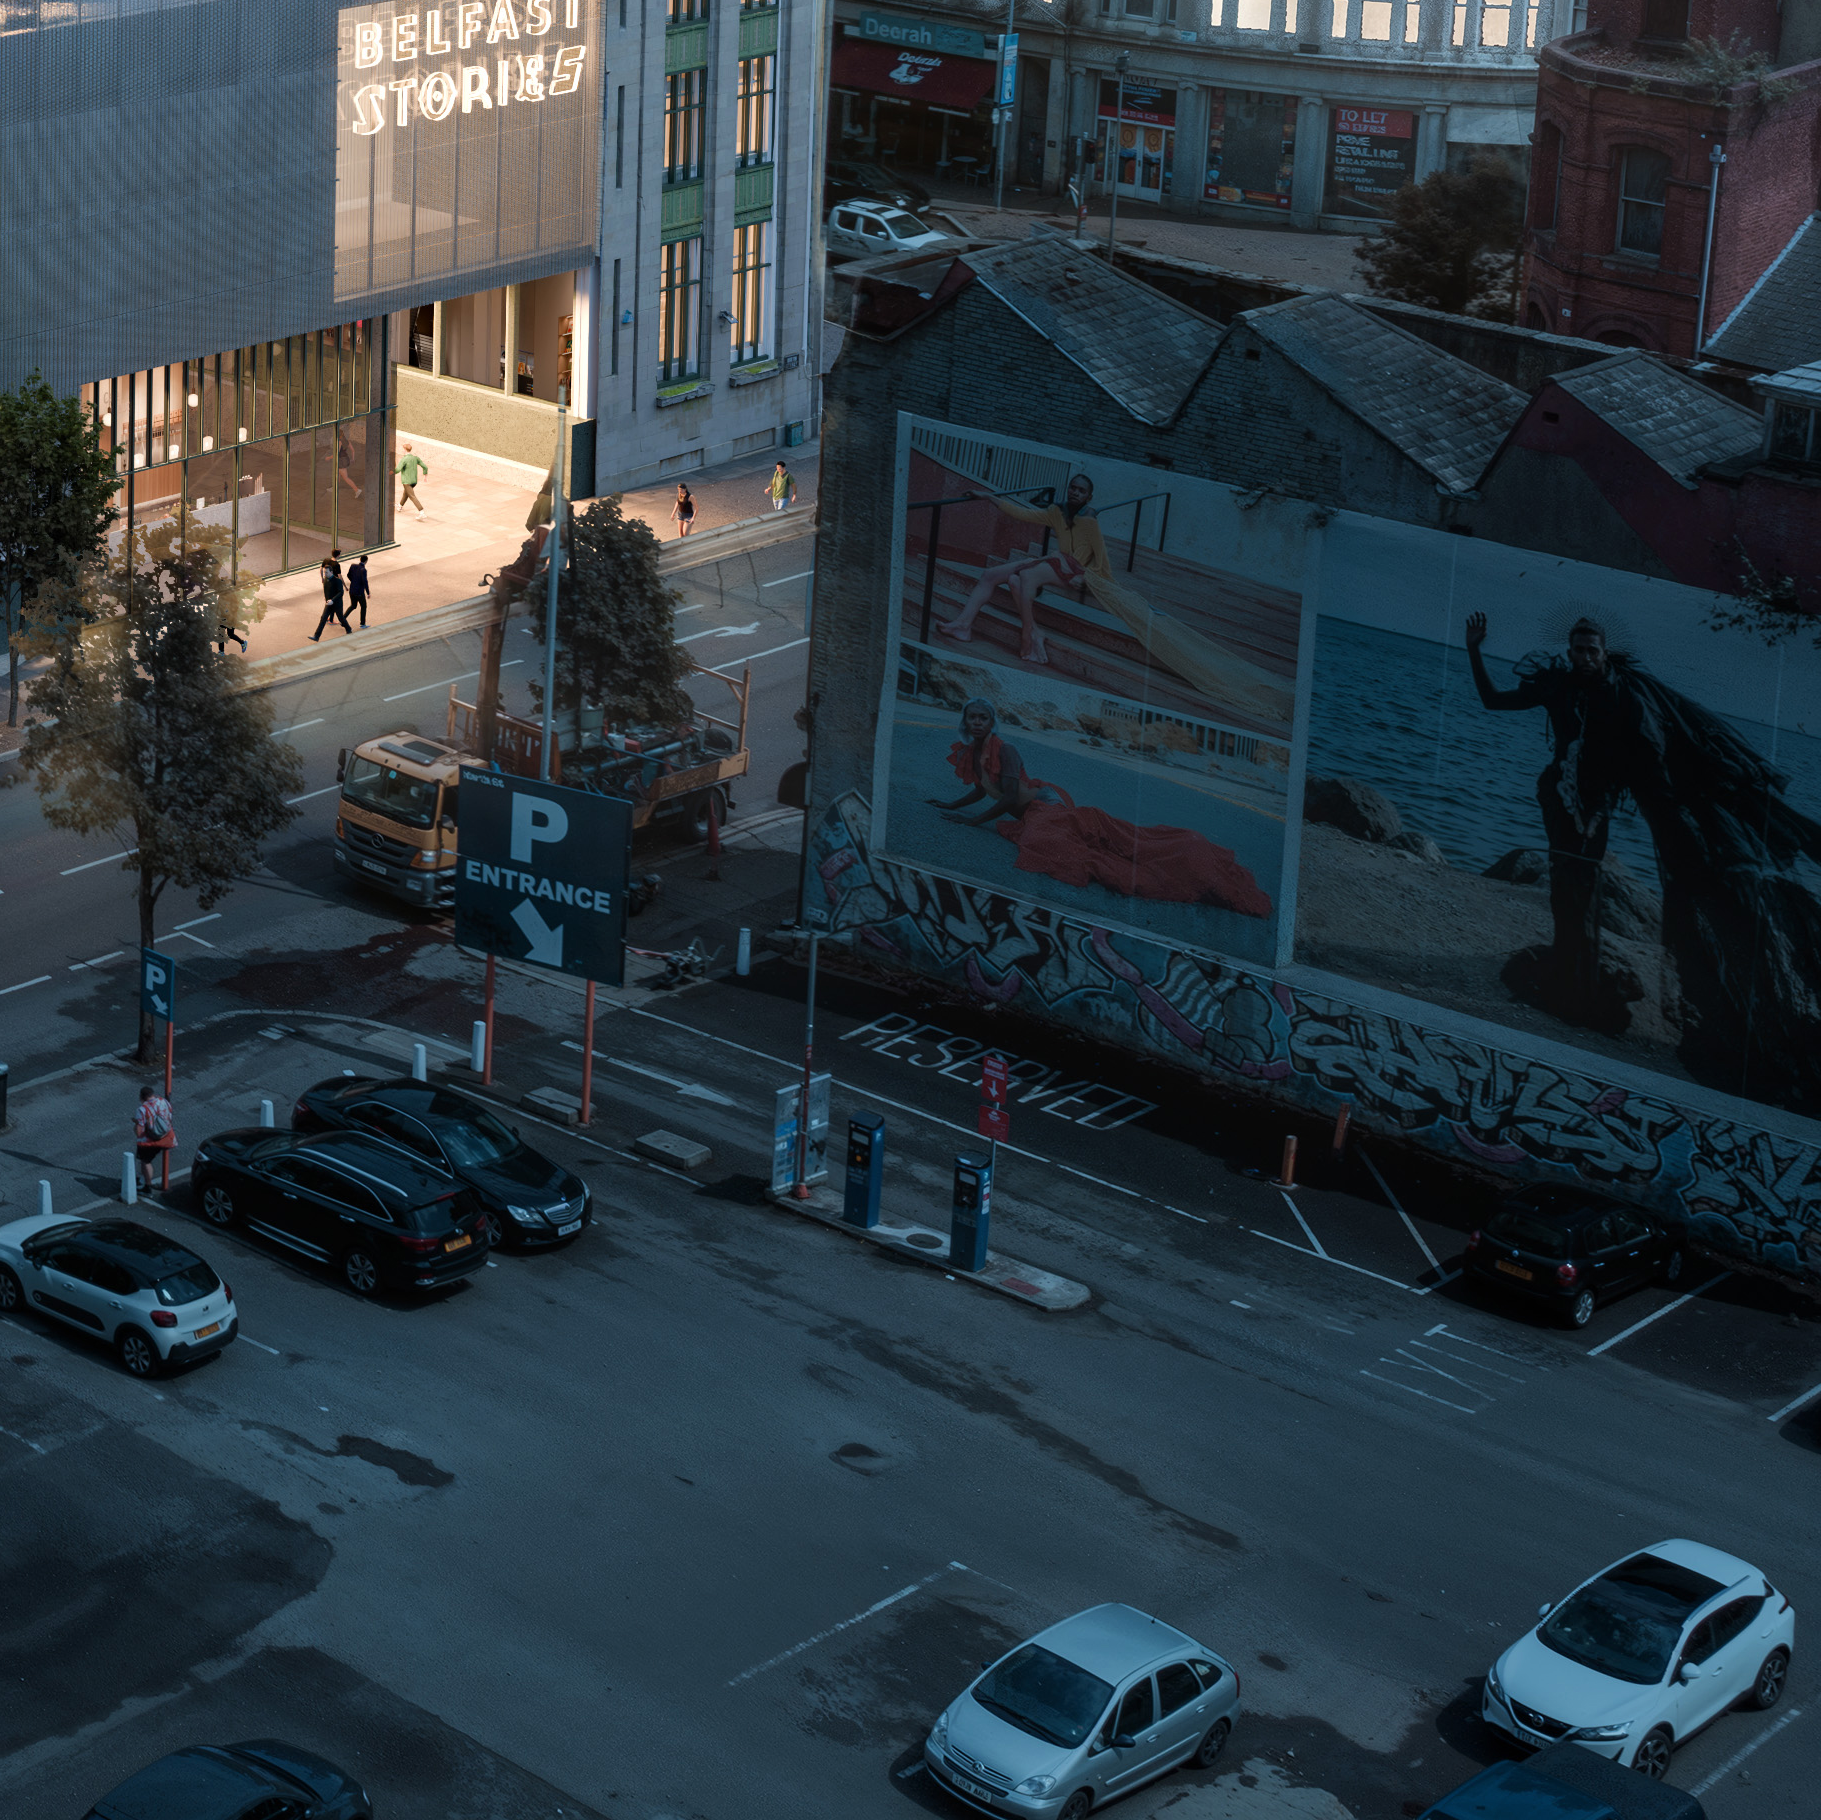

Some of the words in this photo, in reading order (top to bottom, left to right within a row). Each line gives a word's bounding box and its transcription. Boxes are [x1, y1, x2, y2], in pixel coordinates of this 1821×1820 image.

[352, 44, 586, 136] STORIES
[510, 791, 569, 864] P
[465, 860, 611, 915] ENTRANCE
[145, 962, 166, 991] P
